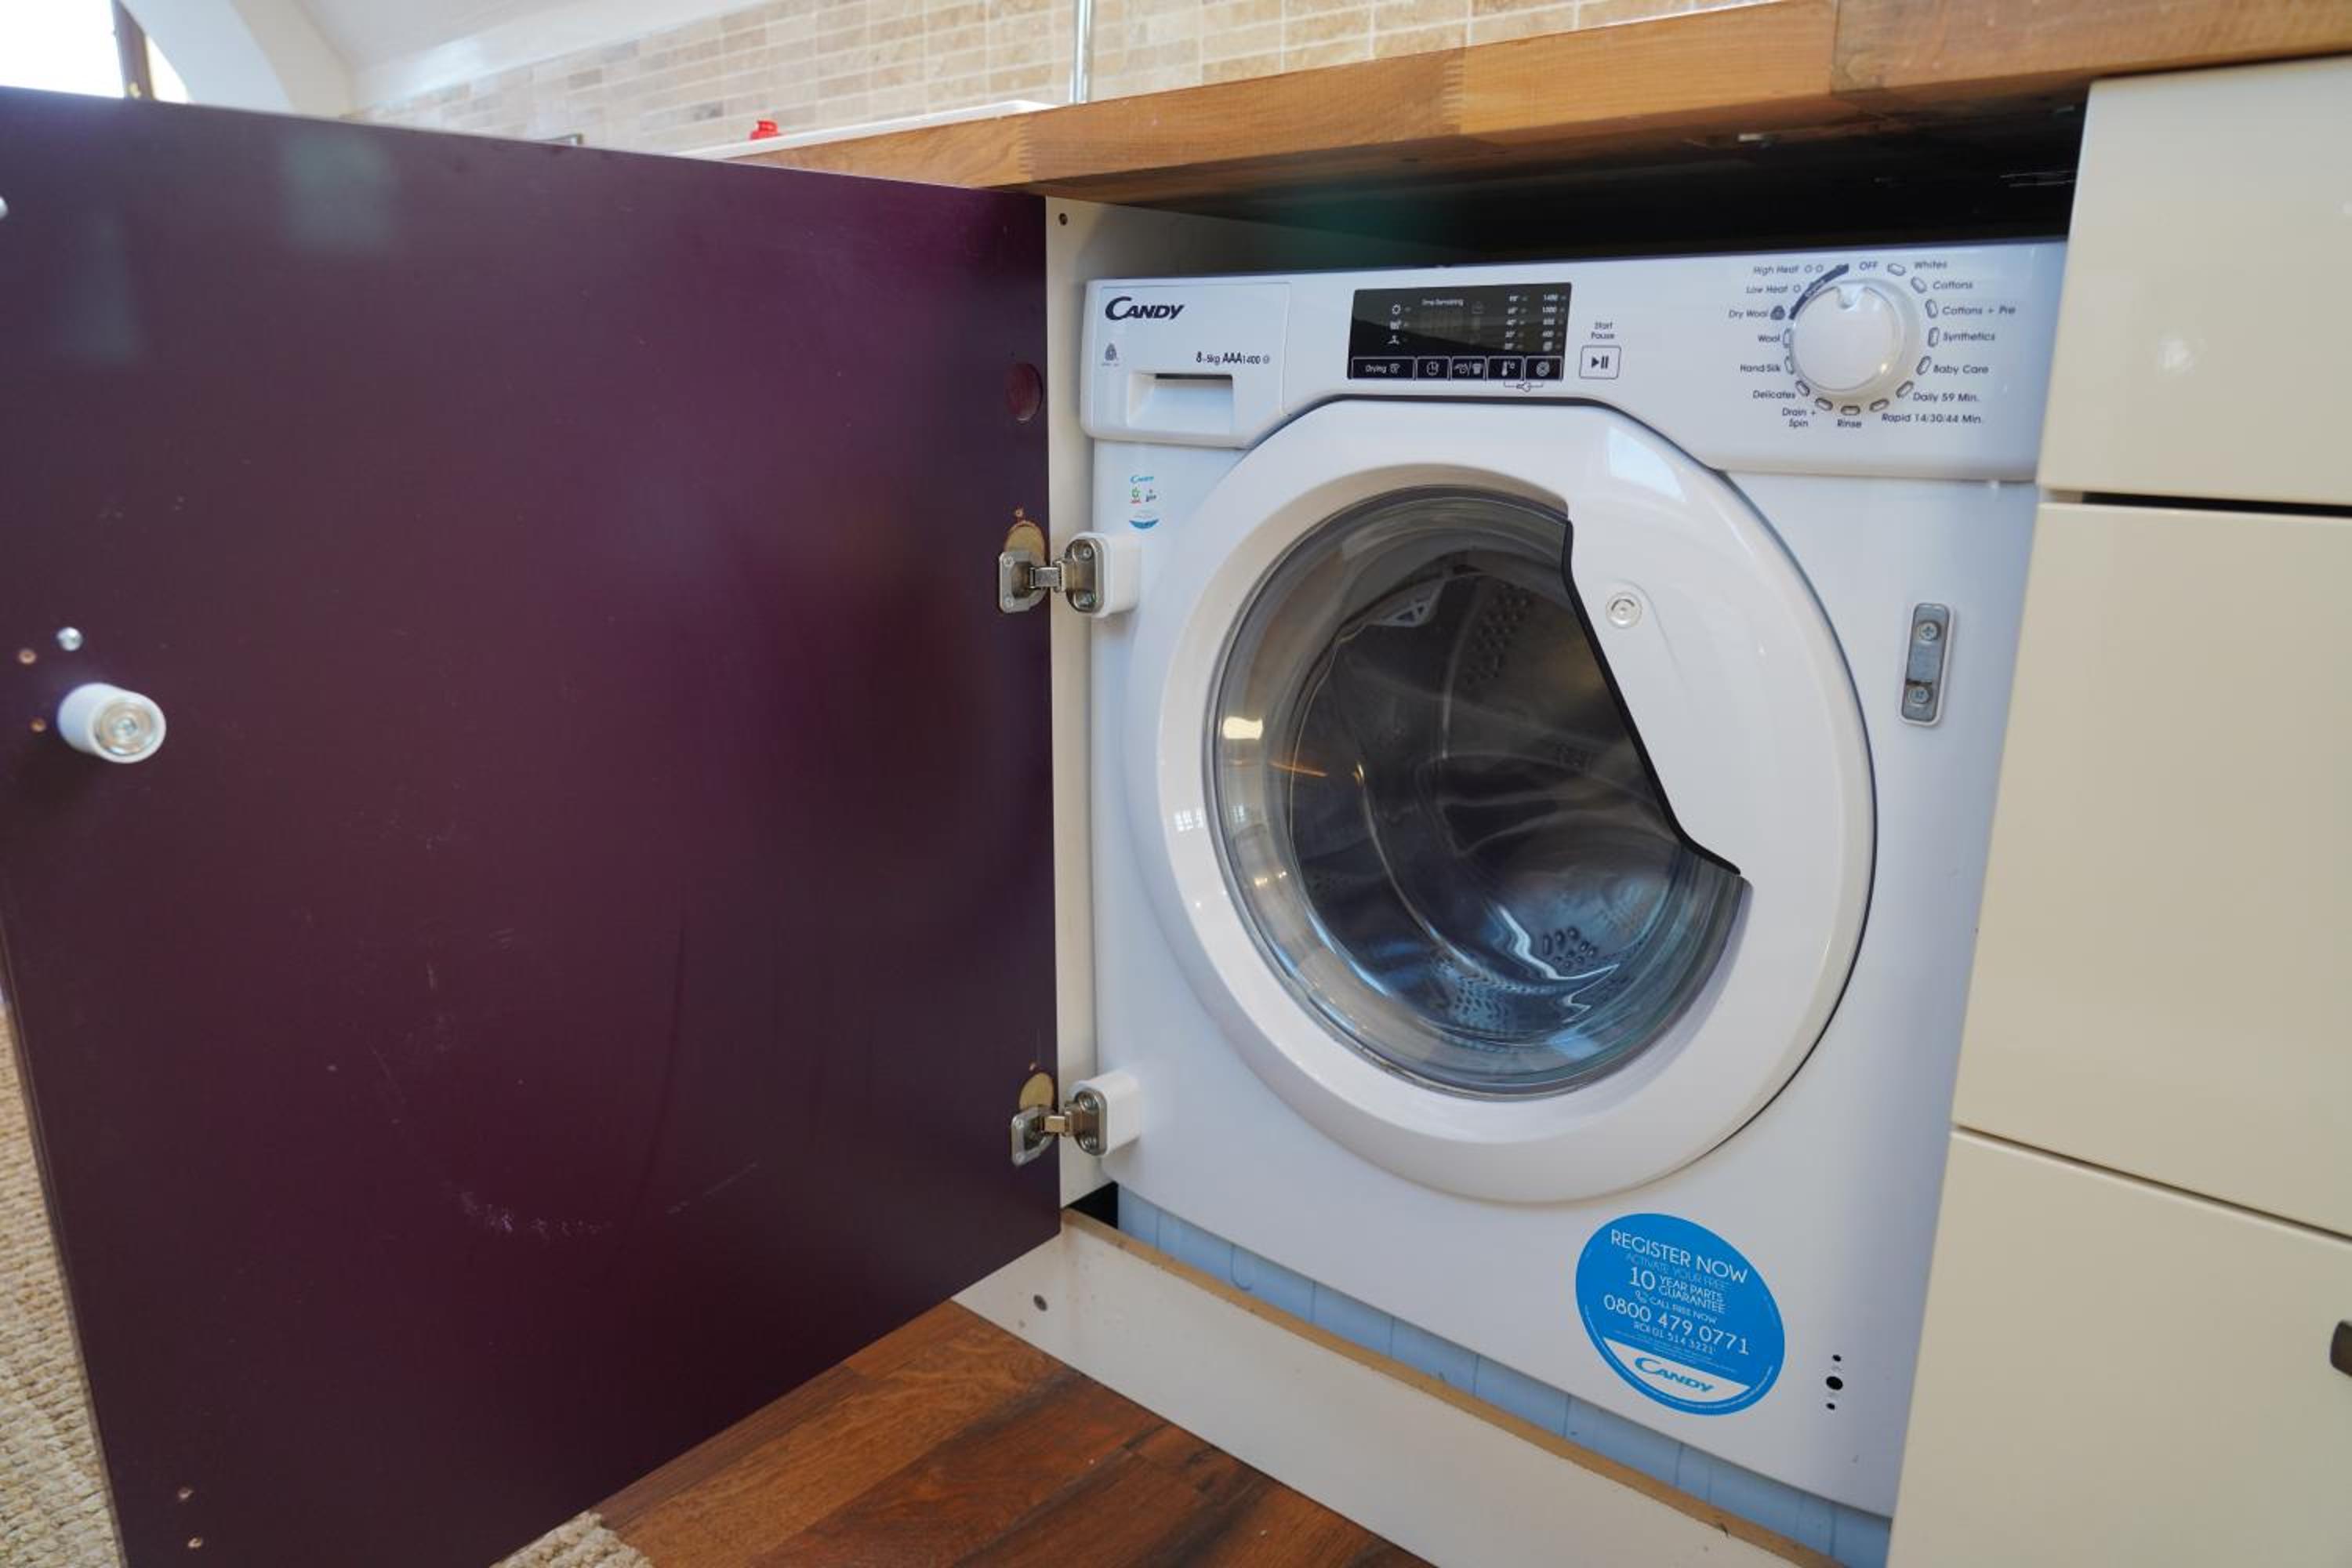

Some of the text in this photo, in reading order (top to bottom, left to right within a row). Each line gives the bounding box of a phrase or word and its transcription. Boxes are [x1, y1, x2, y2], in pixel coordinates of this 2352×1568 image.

[1753, 264, 1798, 275] High Heat
[1859, 261, 1878, 270] OFF
[1915, 260, 1947, 269] Whites
[1766, 285, 1788, 293] Heat
[1933, 280, 1973, 289] Cottons
[1105, 296, 1185, 321] CANDY
[1942, 306, 1983, 315] Cottons
[1729, 310, 1744, 318] Dry
[1758, 334, 1780, 343] Wool
[1943, 332, 1995, 342] Synthetics
[1364, 363, 1387, 374] Drying
[1740, 364, 1781, 372] Hand Silk
[1933, 365, 1989, 375] Baby Care
[1752, 390, 1795, 399] Delicates
[1913, 393, 1980, 403] Daily 59 Min.
[1782, 408, 1806, 416] Drain
[1882, 412, 1911, 423] Rapid
[1788, 419, 1809, 429] Spin
[1837, 419, 1862, 428] Rinse
[1611, 1229, 1748, 1284] REGISTER NOW
[1630, 1265, 1656, 1291] 10
[1659, 1275, 1725, 1303] YEAR PARTS
[1657, 1285, 1726, 1314] GUARANTEE
[1650, 1296, 1719, 1325] CALL FREE NOW
[1603, 1294, 1652, 1323] 0800
[1657, 1312, 1693, 1337] 479
[1699, 1325, 1750, 1356] 0771
[1635, 1356, 1715, 1393] CANDY
